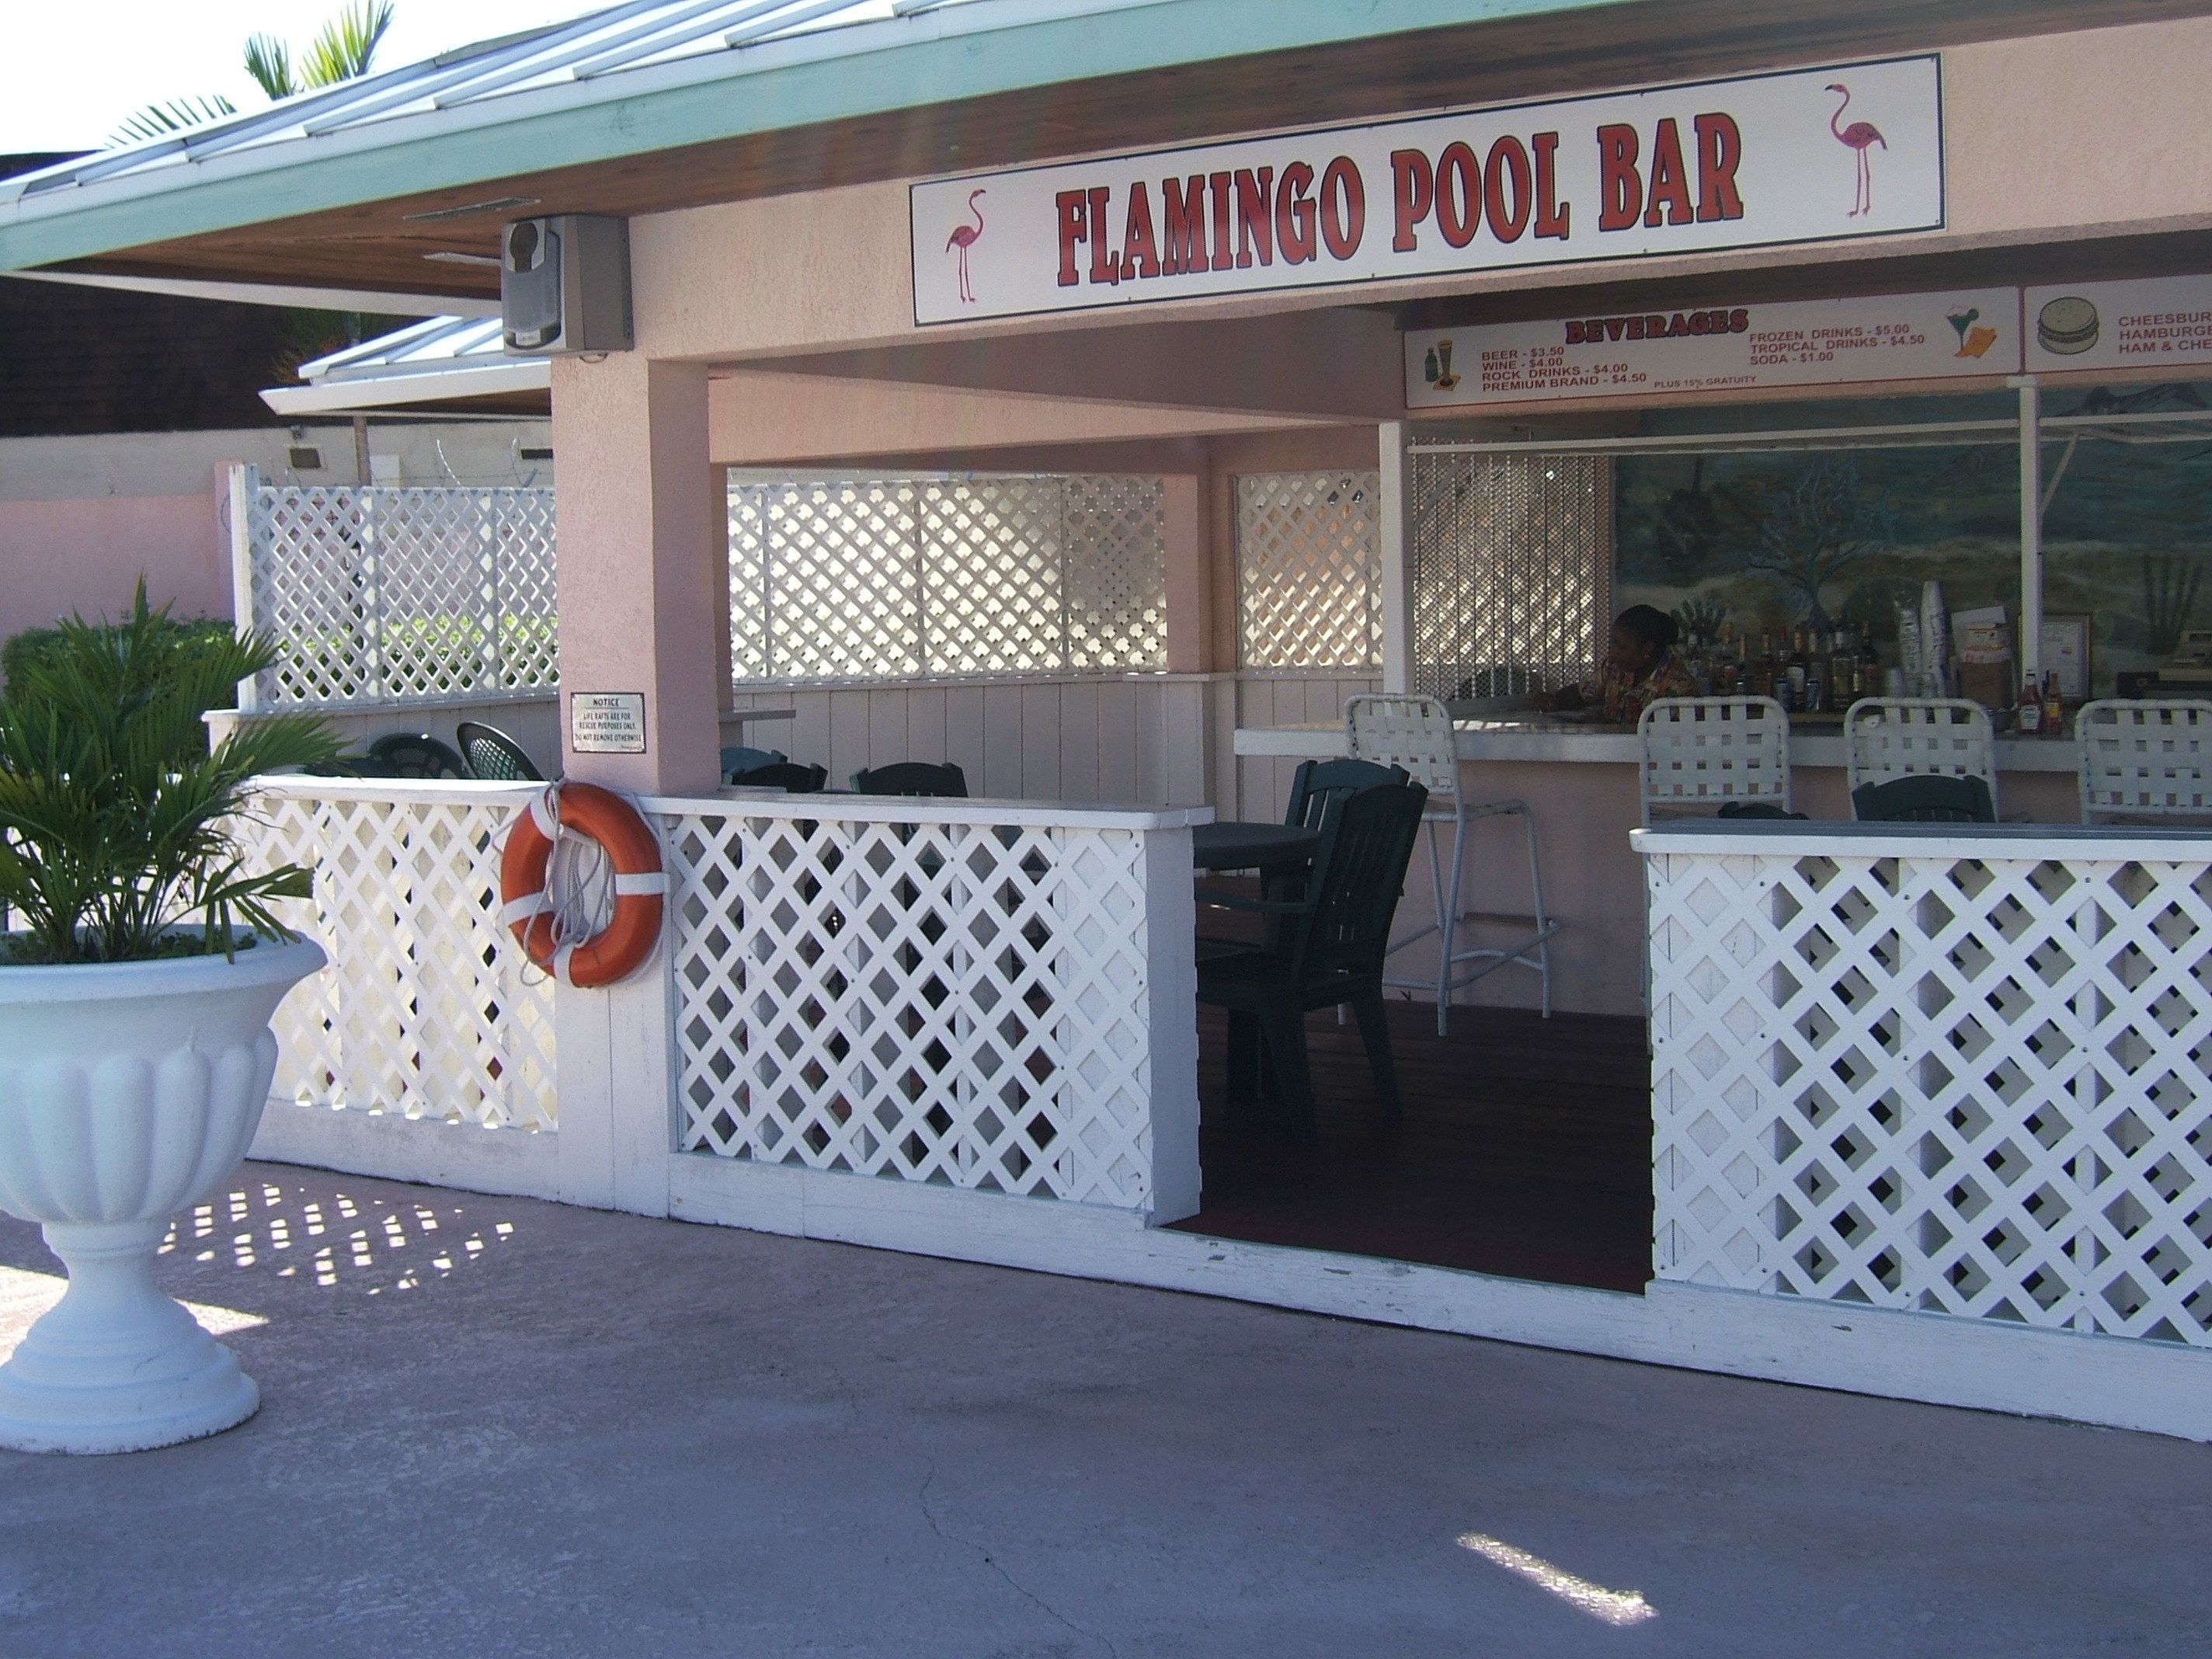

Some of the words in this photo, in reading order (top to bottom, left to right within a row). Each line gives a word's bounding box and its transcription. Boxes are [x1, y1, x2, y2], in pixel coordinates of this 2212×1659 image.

[1056, 155, 1365, 287] FLAMINGO
[1390, 134, 1570, 252] POOL
[1597, 112, 1744, 232] BAR
[1566, 308, 1749, 344] BEVERAGES
[1749, 331, 1803, 343] FROZEN
[1812, 326, 1862, 339] DRINKS
[1876, 324, 1910, 336] $5.00
[1751, 342, 1818, 354] TROPICAL
[1826, 337, 1878, 350] DRINKS
[1890, 335, 1925, 346] $4.50
[2119, 343, 2156, 353] HAM
[2162, 341, 2172, 351] &
[2178, 339, 2212, 350] CHE
[1482, 350, 1518, 360] BEER
[1530, 346, 1564, 358] $3.50
[1750, 353, 1788, 365] SODA
[1800, 351, 1834, 363] $1.00
[1482, 360, 1516, 370] WINE
[1529, 357, 1563, 368] $4.00
[1482, 371, 1521, 381] ROCK
[1529, 366, 1581, 378] DRINKS
[1594, 363, 1628, 374] $4.00
[1483, 380, 1546, 391] PREMIUM
[1550, 376, 1599, 388] BRAND
[1612, 373, 1647, 384] $4.50
[1654, 380, 1681, 388] PLUS
[1706, 375, 1757, 385] GRATUITY
[593, 697, 620, 707] NOTICE
[621, 712, 631, 721] FOR
